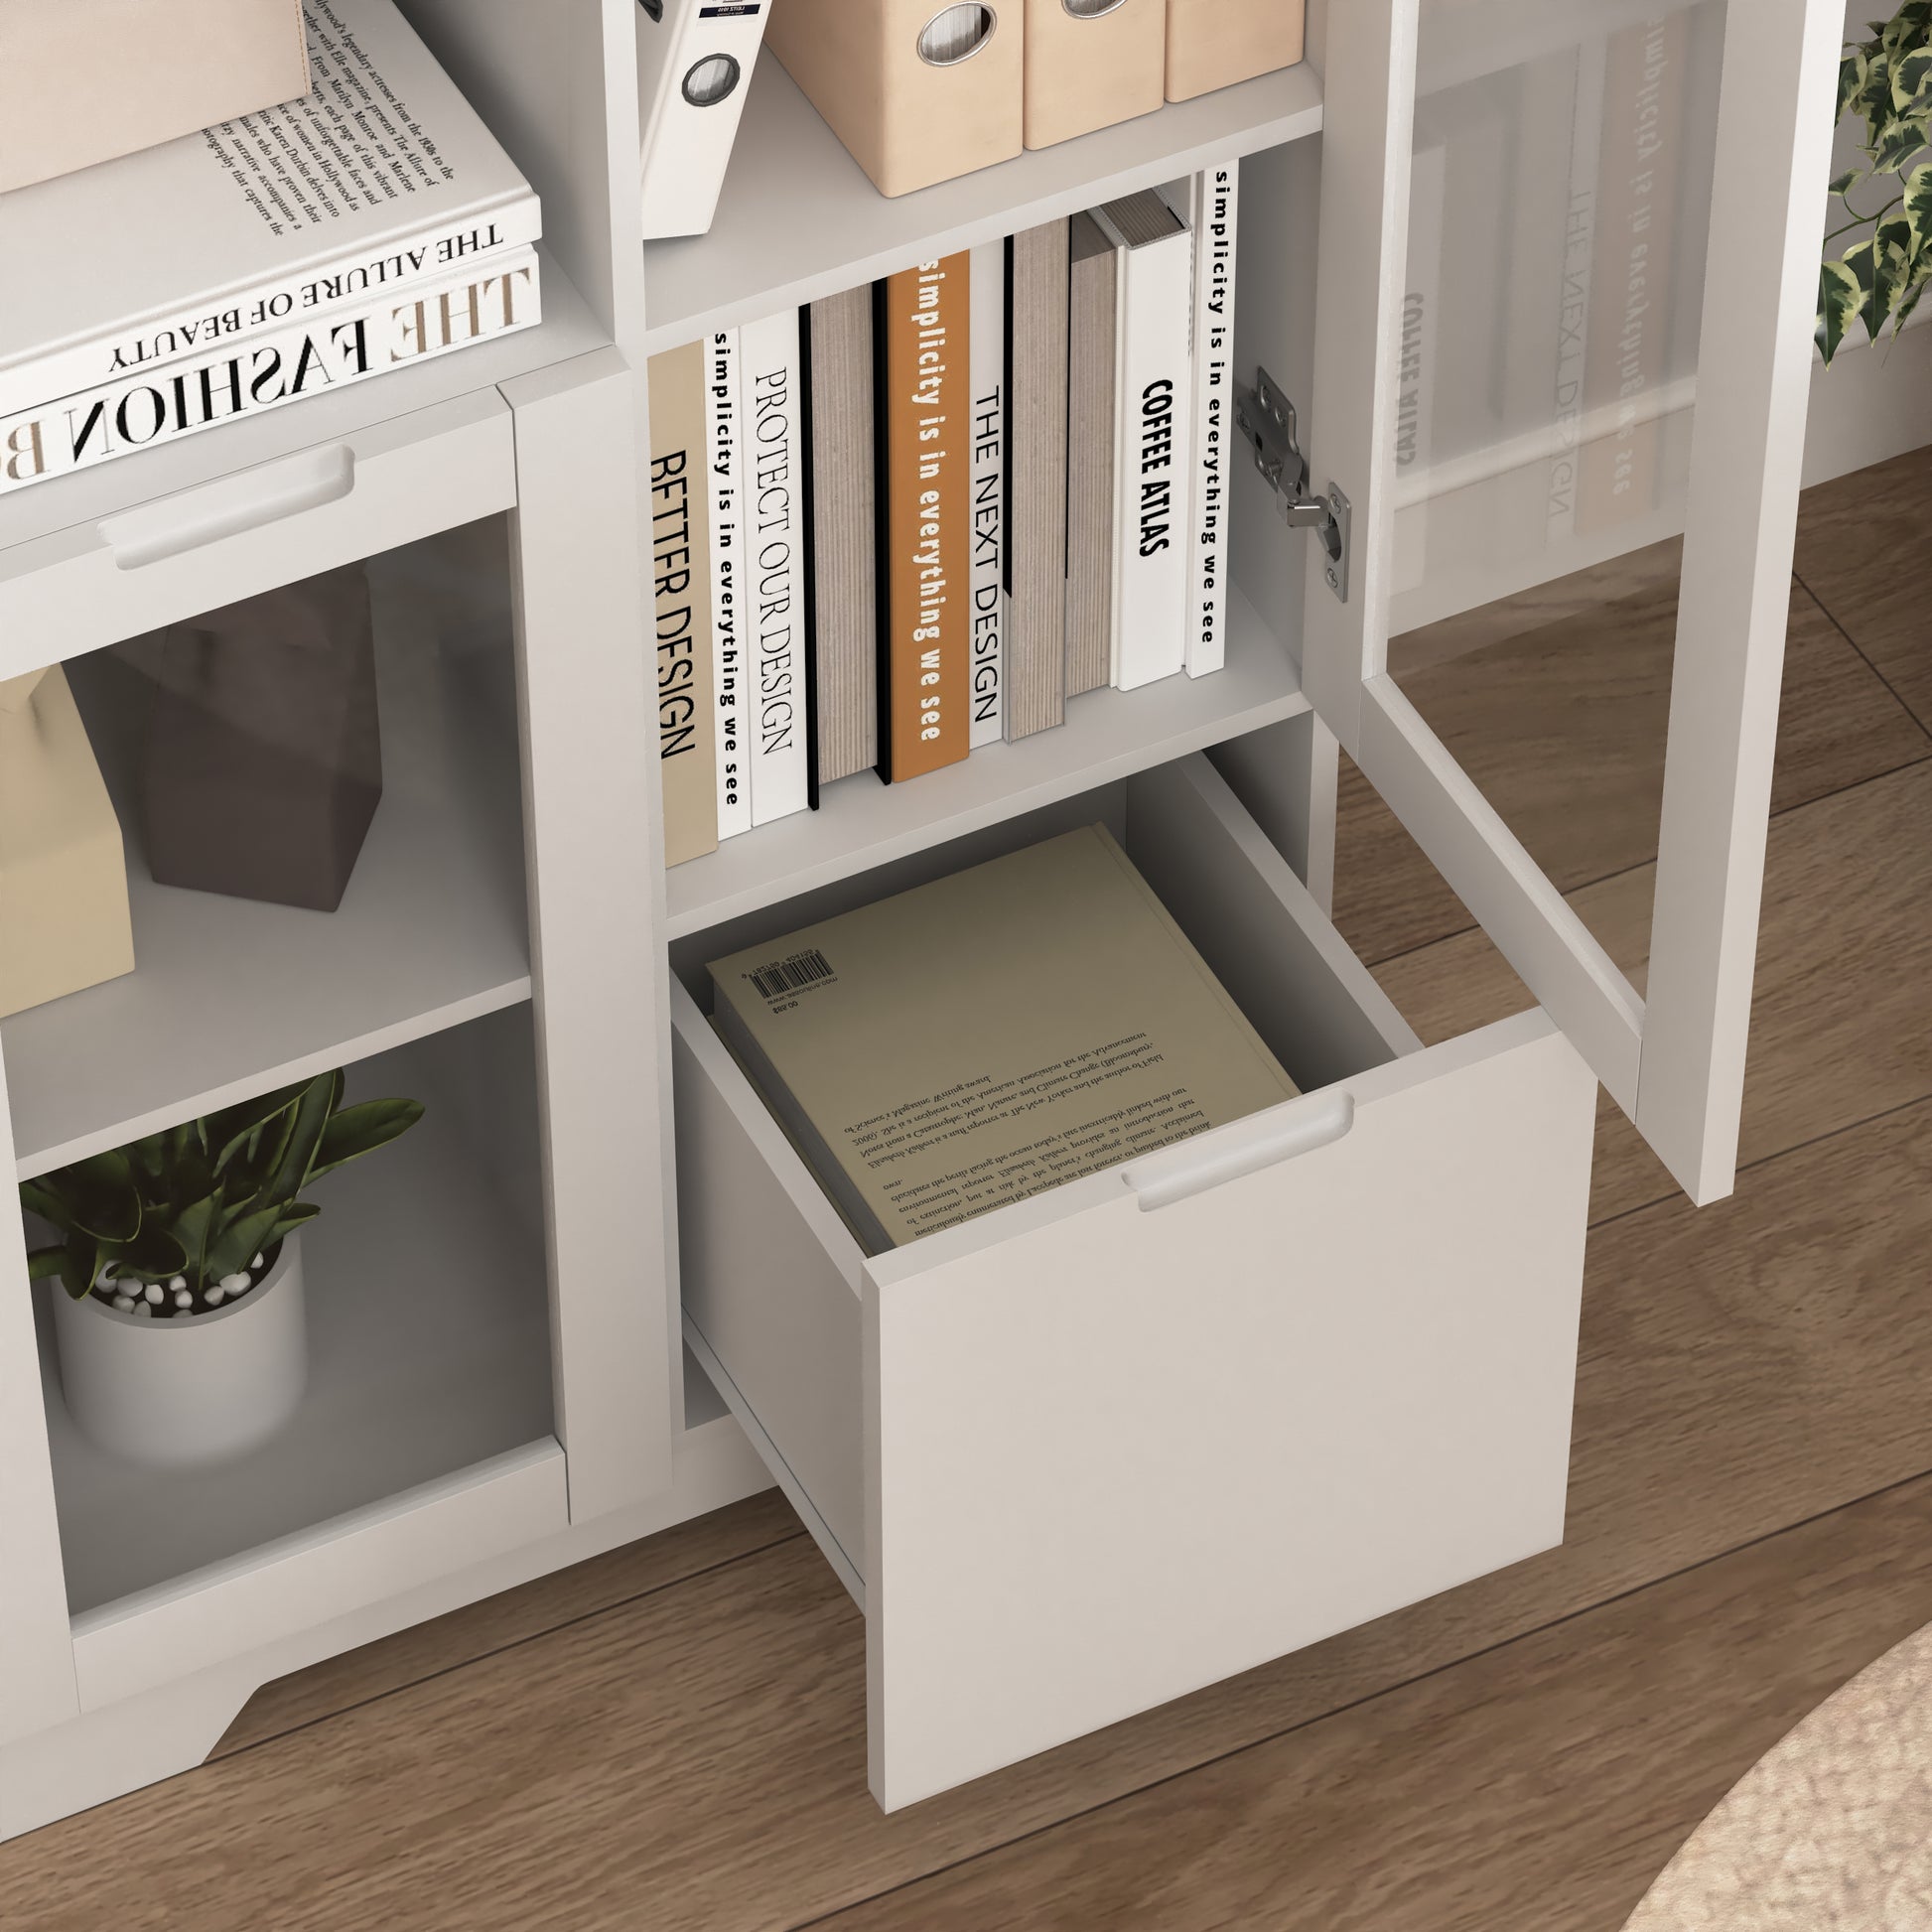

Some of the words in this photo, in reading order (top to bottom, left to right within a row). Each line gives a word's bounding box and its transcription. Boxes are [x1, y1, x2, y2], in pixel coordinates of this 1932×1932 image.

[312, 56, 331, 76] From
[329, 78, 354, 108] Marilyn
[351, 110, 378, 141] Monroe
[375, 144, 394, 159] and
[389, 161, 416, 193] Marlene
[319, 34, 339, 51] with
[332, 51, 347, 66] Elle
[344, 68, 372, 104] magazine,
[366, 104, 398, 135] presents
[394, 135, 410, 151] The
[406, 151, 428, 176] Allure
[342, 33, 372, 71] legendary
[368, 71, 397, 102] actresses
[393, 102, 411, 122] from
[408, 123, 422, 137] the
[440, 166, 455, 180] the
[232, 139, 261, 172] narrative
[258, 175, 297, 221] accompanies
[256, 139, 272, 156] who
[269, 156, 286, 175] have
[279, 177, 306, 203] proven
[303, 204, 322, 223] their
[270, 125, 291, 150] Karen
[286, 148, 311, 177] Durbin
[306, 176, 328, 201] delves
[324, 201, 340, 217] into
[292, 124, 317, 151] women
[319, 160, 356, 202] Hollywood
[311, 118, 352, 168] unforgettable
[348, 169, 366, 189] faces
[363, 190, 381, 205] and
[324, 105, 345, 122] each
[335, 125, 355, 142] page
[360, 154, 376, 169] this
[372, 171, 400, 199] vibrant
[232, 170, 251, 187] that
[245, 189, 272, 220] captures
[269, 222, 283, 236] the
[437, 223, 503, 264] THE
[1208, 172, 1230, 314] simplicity
[250, 293, 293, 326] OF
[301, 246, 428, 308] ALLURE
[109, 308, 242, 373] BEAUTY
[910, 259, 946, 405] simplicity
[1211, 328, 1226, 349] is
[712, 334, 733, 476] simplicity
[1210, 361, 1226, 386] in
[756, 366, 791, 534] PROTECT
[920, 416, 945, 440] is
[976, 385, 999, 463] THE
[1142, 380, 1173, 474] COFFEE
[719, 489, 734, 510] is
[920, 452, 945, 479] in
[1201, 399, 1221, 545] everything
[651, 450, 690, 598] BETTER
[720, 524, 735, 547] in
[976, 474, 999, 569] NEXT
[1140, 481, 1170, 557] ATLAS
[759, 542, 791, 624] OUR
[913, 491, 945, 641] everything
[1203, 555, 1216, 590] we
[718, 561, 738, 706] everything
[975, 584, 998, 722] DESIGN
[1201, 601, 1214, 643] see
[656, 606, 695, 759] DESIGN
[760, 624, 793, 756] DESIGN
[919, 648, 941, 687] we
[725, 718, 736, 751] we
[921, 697, 939, 740] see
[726, 763, 737, 804] see
